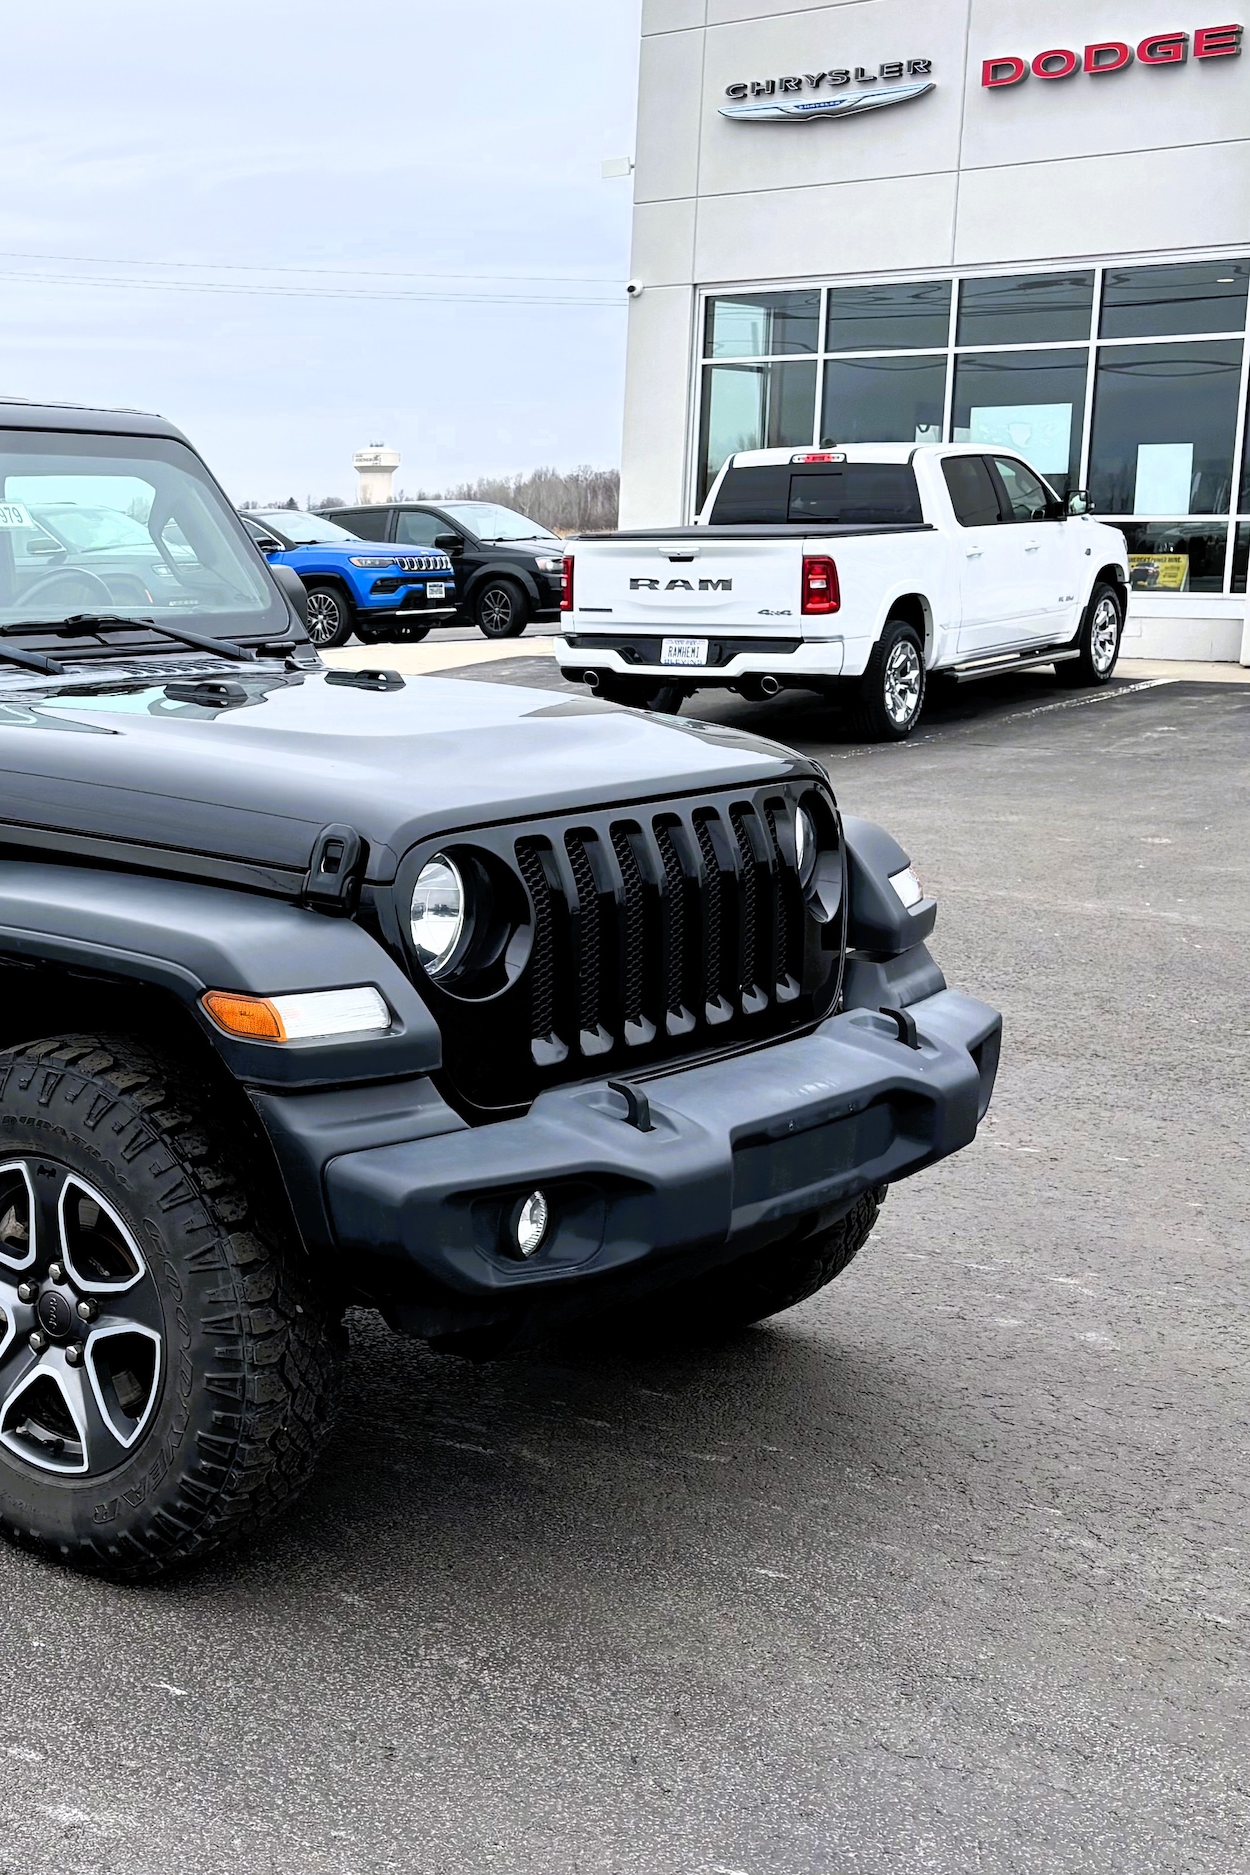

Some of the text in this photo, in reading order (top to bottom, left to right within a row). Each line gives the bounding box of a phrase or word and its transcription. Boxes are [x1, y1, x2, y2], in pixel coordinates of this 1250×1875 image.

[981, 23, 1244, 90] DODGE
[725, 58, 933, 99] CHRYSLER
[629, 577, 733, 591] RAM
[667, 645, 701, 659] RAMHEMI
[92, 1216, 195, 1525] GOODYEAR
